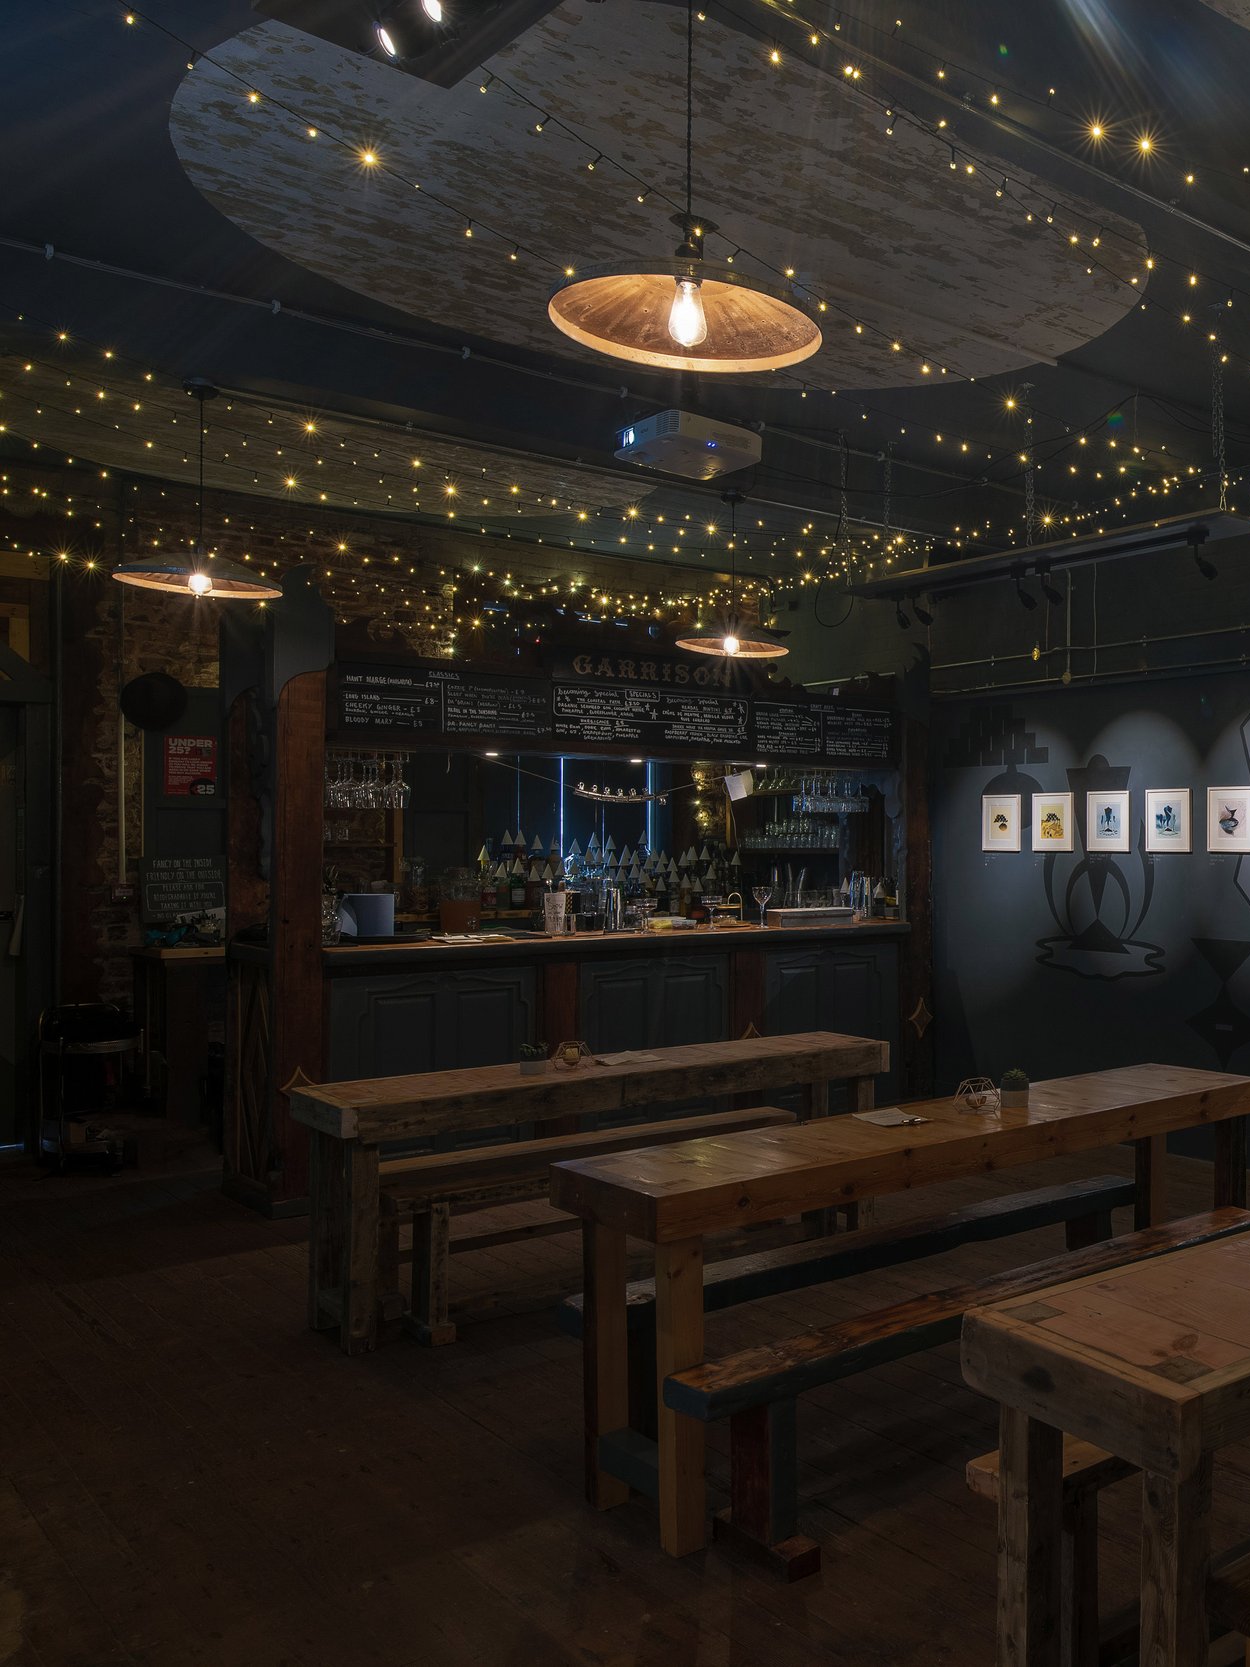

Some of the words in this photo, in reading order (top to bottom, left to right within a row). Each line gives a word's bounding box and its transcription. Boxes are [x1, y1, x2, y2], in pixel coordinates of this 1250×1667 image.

[428, 671, 460, 679] CLASSICS
[572, 655, 733, 688] GARRISON
[630, 690, 656, 699] SPECIALS
[168, 738, 213, 748] UNDER
[196, 785, 215, 795] 25
[152, 859, 172, 868] FANCY
[146, 872, 175, 881] FRIENDLY
[176, 871, 184, 880] ON
[197, 869, 221, 879] OUTSIDE
